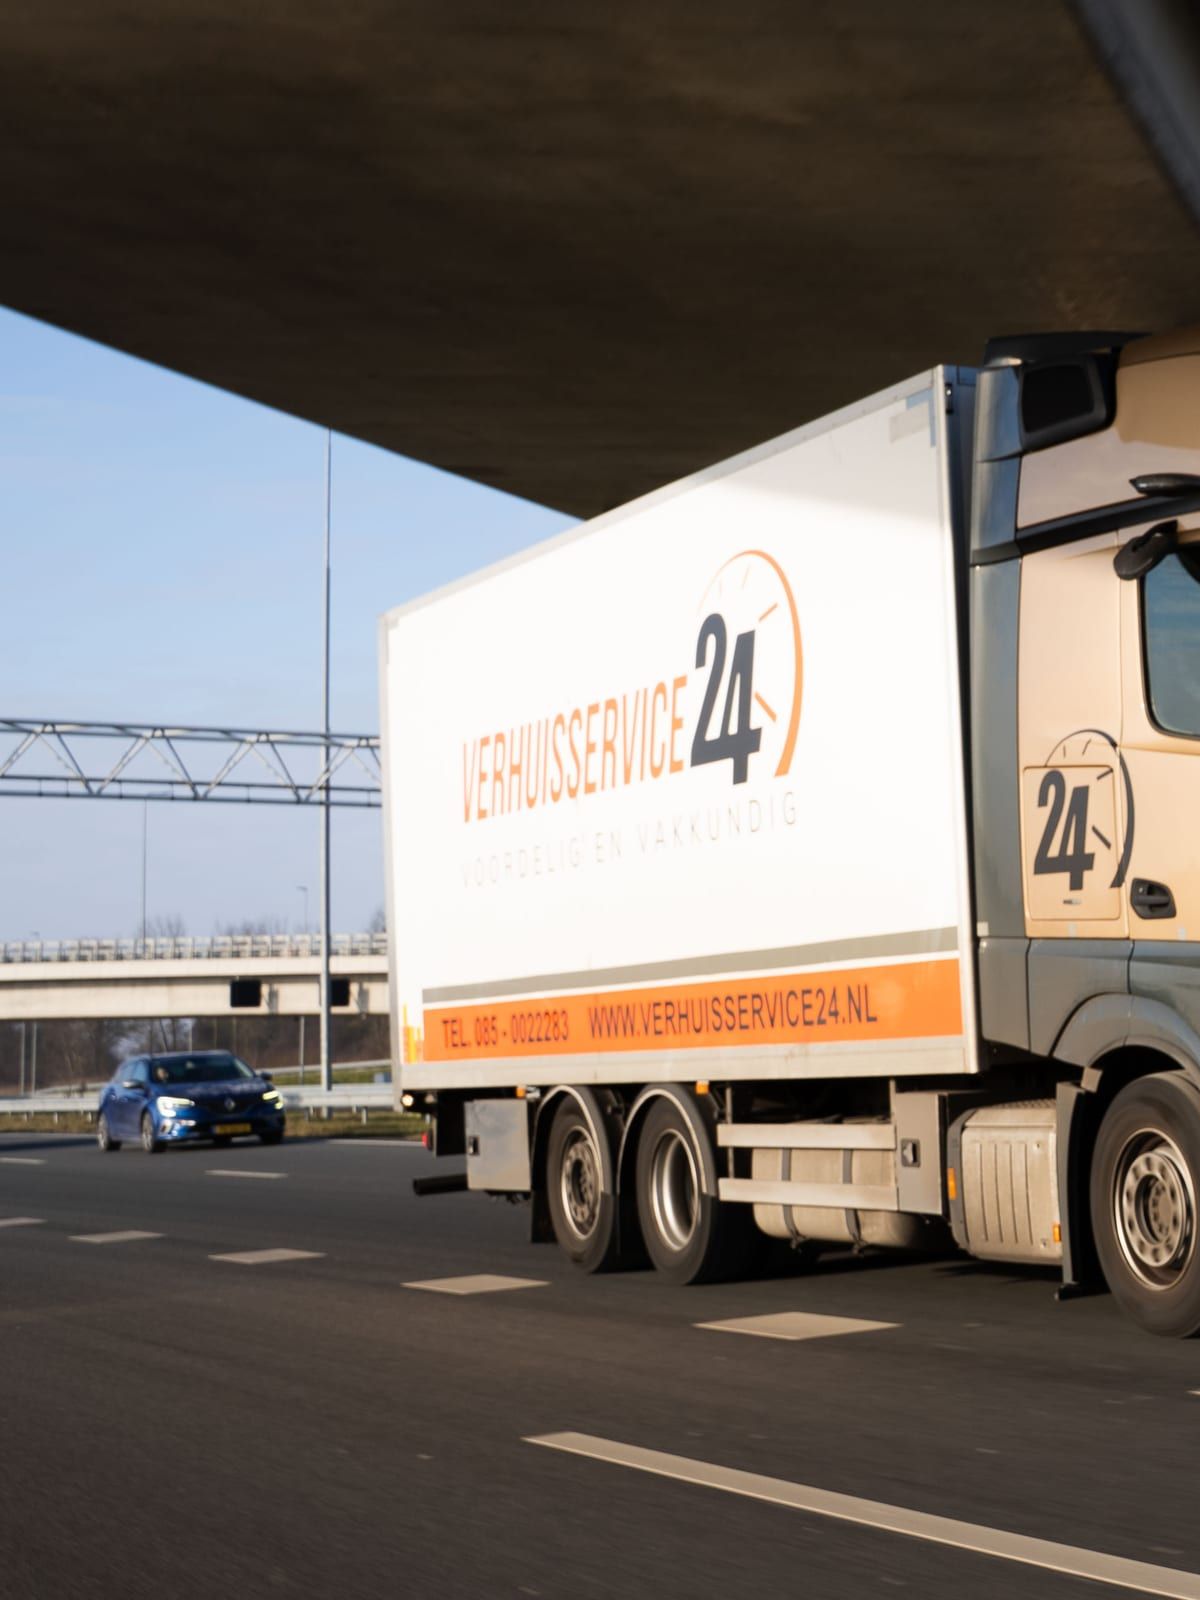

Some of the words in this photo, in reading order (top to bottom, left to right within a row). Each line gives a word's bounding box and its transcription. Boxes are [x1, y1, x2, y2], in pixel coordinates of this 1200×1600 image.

[462, 675, 687, 823] VERHUISSERVICE
[691, 612, 763, 785] 24
[461, 834, 581, 888] VOORDELIG
[594, 829, 621, 863] EN
[638, 791, 796, 852] VAKKUNDIG
[1034, 769, 1094, 890] 24
[442, 1018, 471, 1048] TEL.
[588, 984, 878, 1038] WWW.VERHUISSERVICE24.NL
